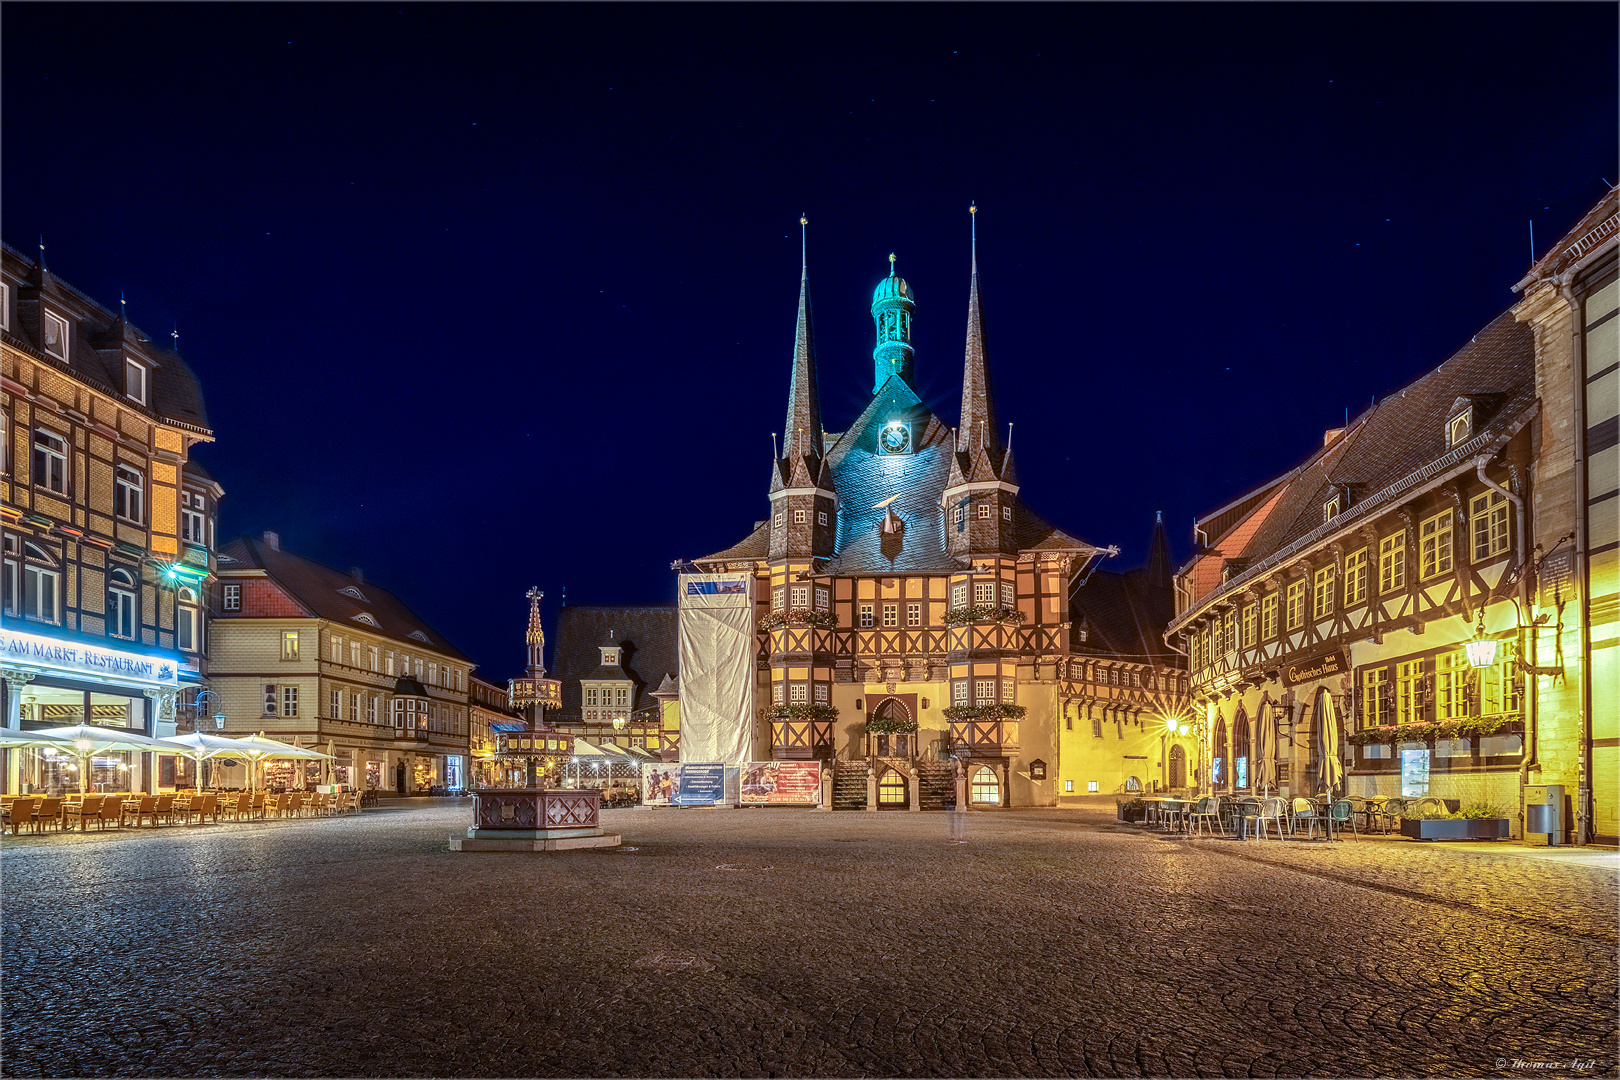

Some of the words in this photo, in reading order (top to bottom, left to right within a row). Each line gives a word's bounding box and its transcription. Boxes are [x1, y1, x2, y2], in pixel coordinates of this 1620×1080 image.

[8, 639, 30, 655] AM
[33, 642, 78, 662] MARKT
[85, 650, 154, 675] RESTAURANT
[1322, 664, 1338, 674] Haus
